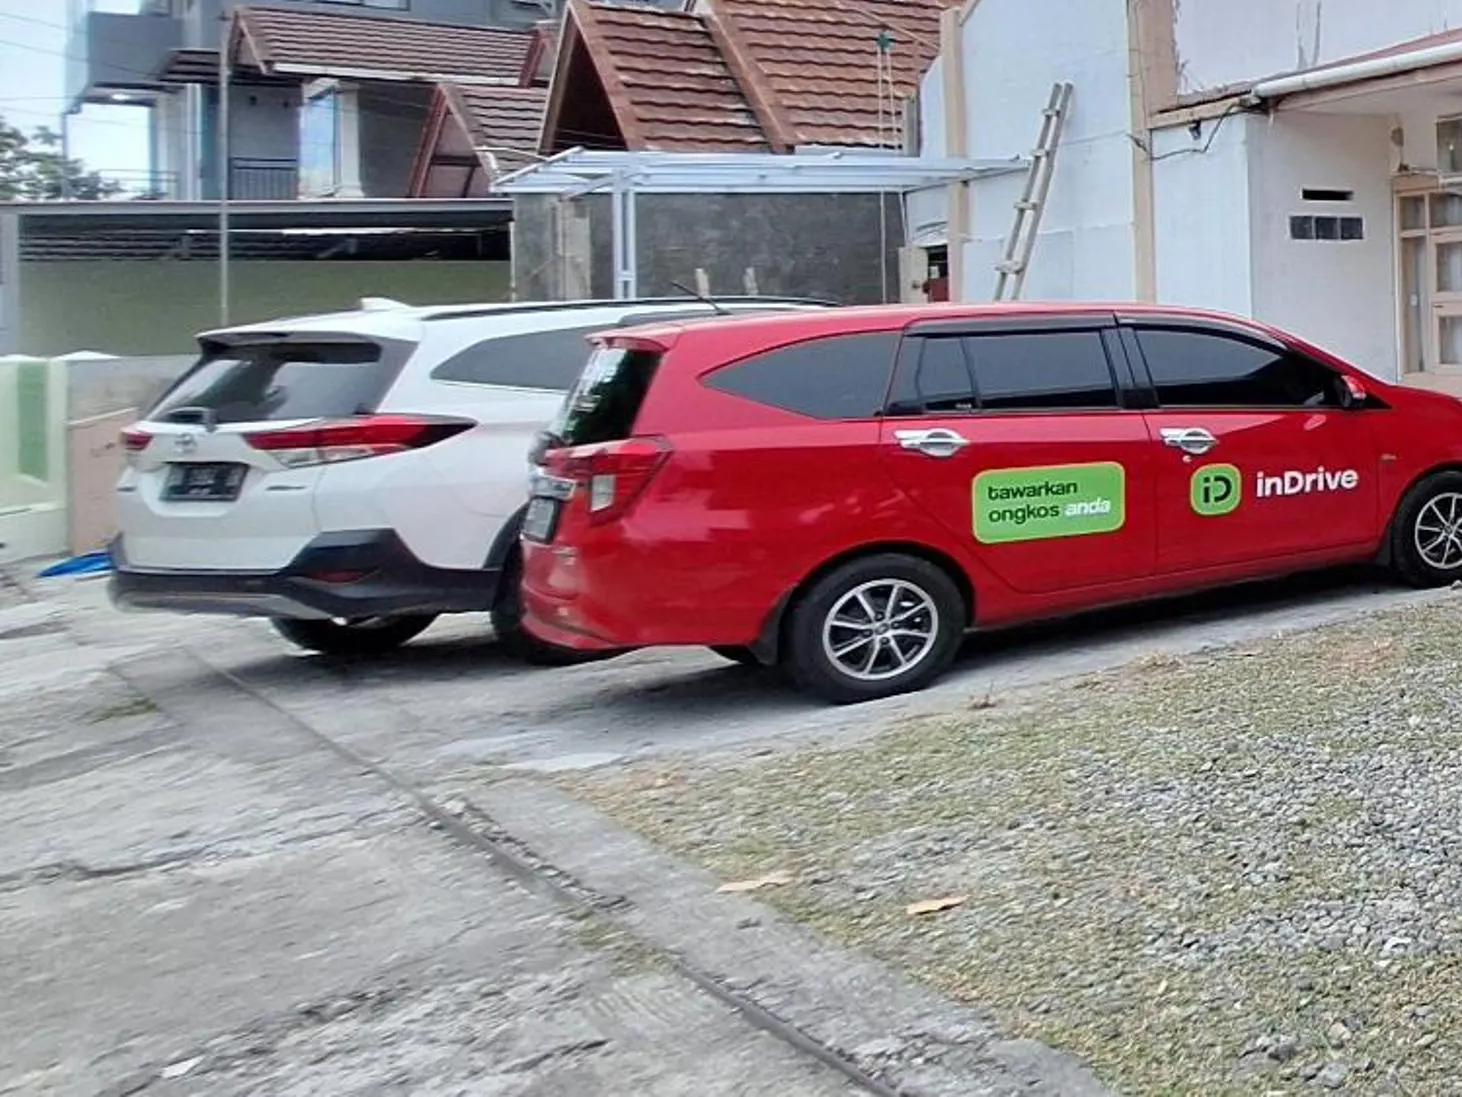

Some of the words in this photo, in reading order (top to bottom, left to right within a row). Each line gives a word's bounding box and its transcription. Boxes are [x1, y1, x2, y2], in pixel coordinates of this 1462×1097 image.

[987, 481, 1078, 500] tawarkan
[1256, 466, 1359, 497] inDrive
[988, 504, 1060, 525] ongkos
[1064, 497, 1111, 517] anda
